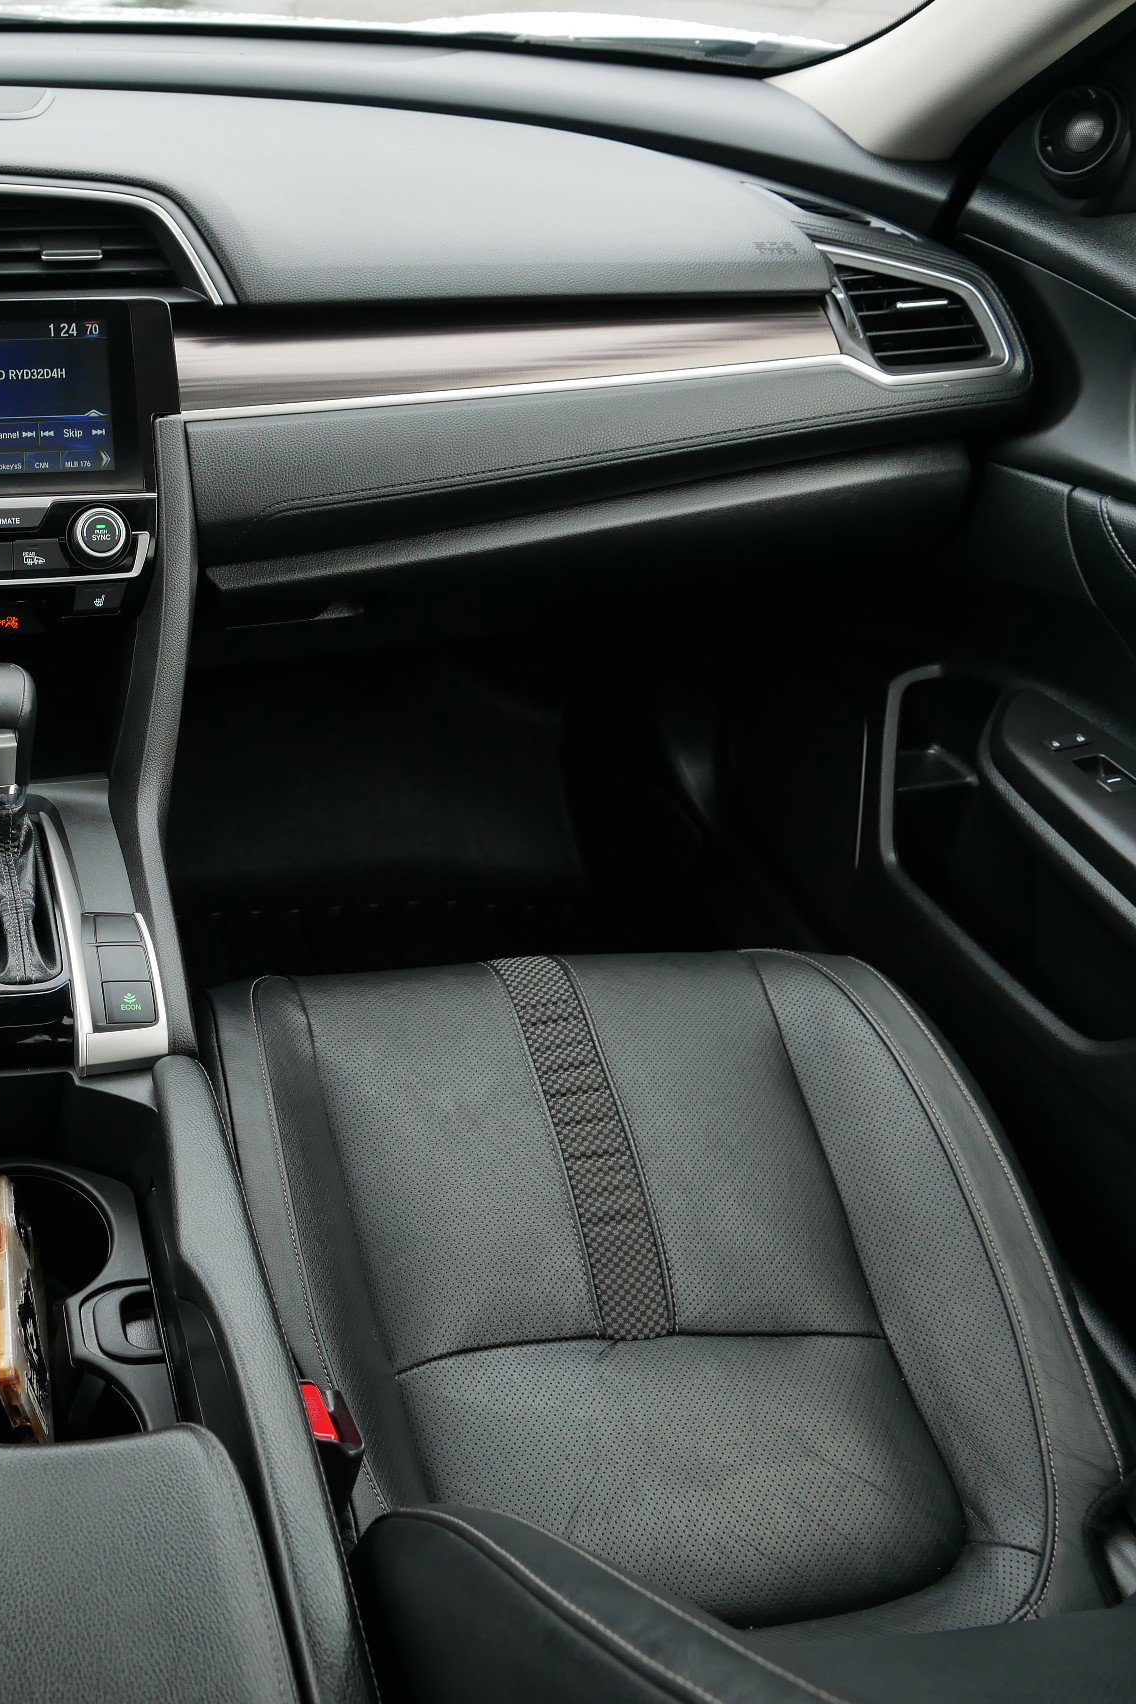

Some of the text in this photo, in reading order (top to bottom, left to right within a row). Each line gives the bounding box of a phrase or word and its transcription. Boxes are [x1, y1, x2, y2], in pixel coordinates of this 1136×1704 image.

[86, 323, 99, 335] 70
[9, 368, 66, 380] RYD32D4H
[63, 428, 83, 438] Skip
